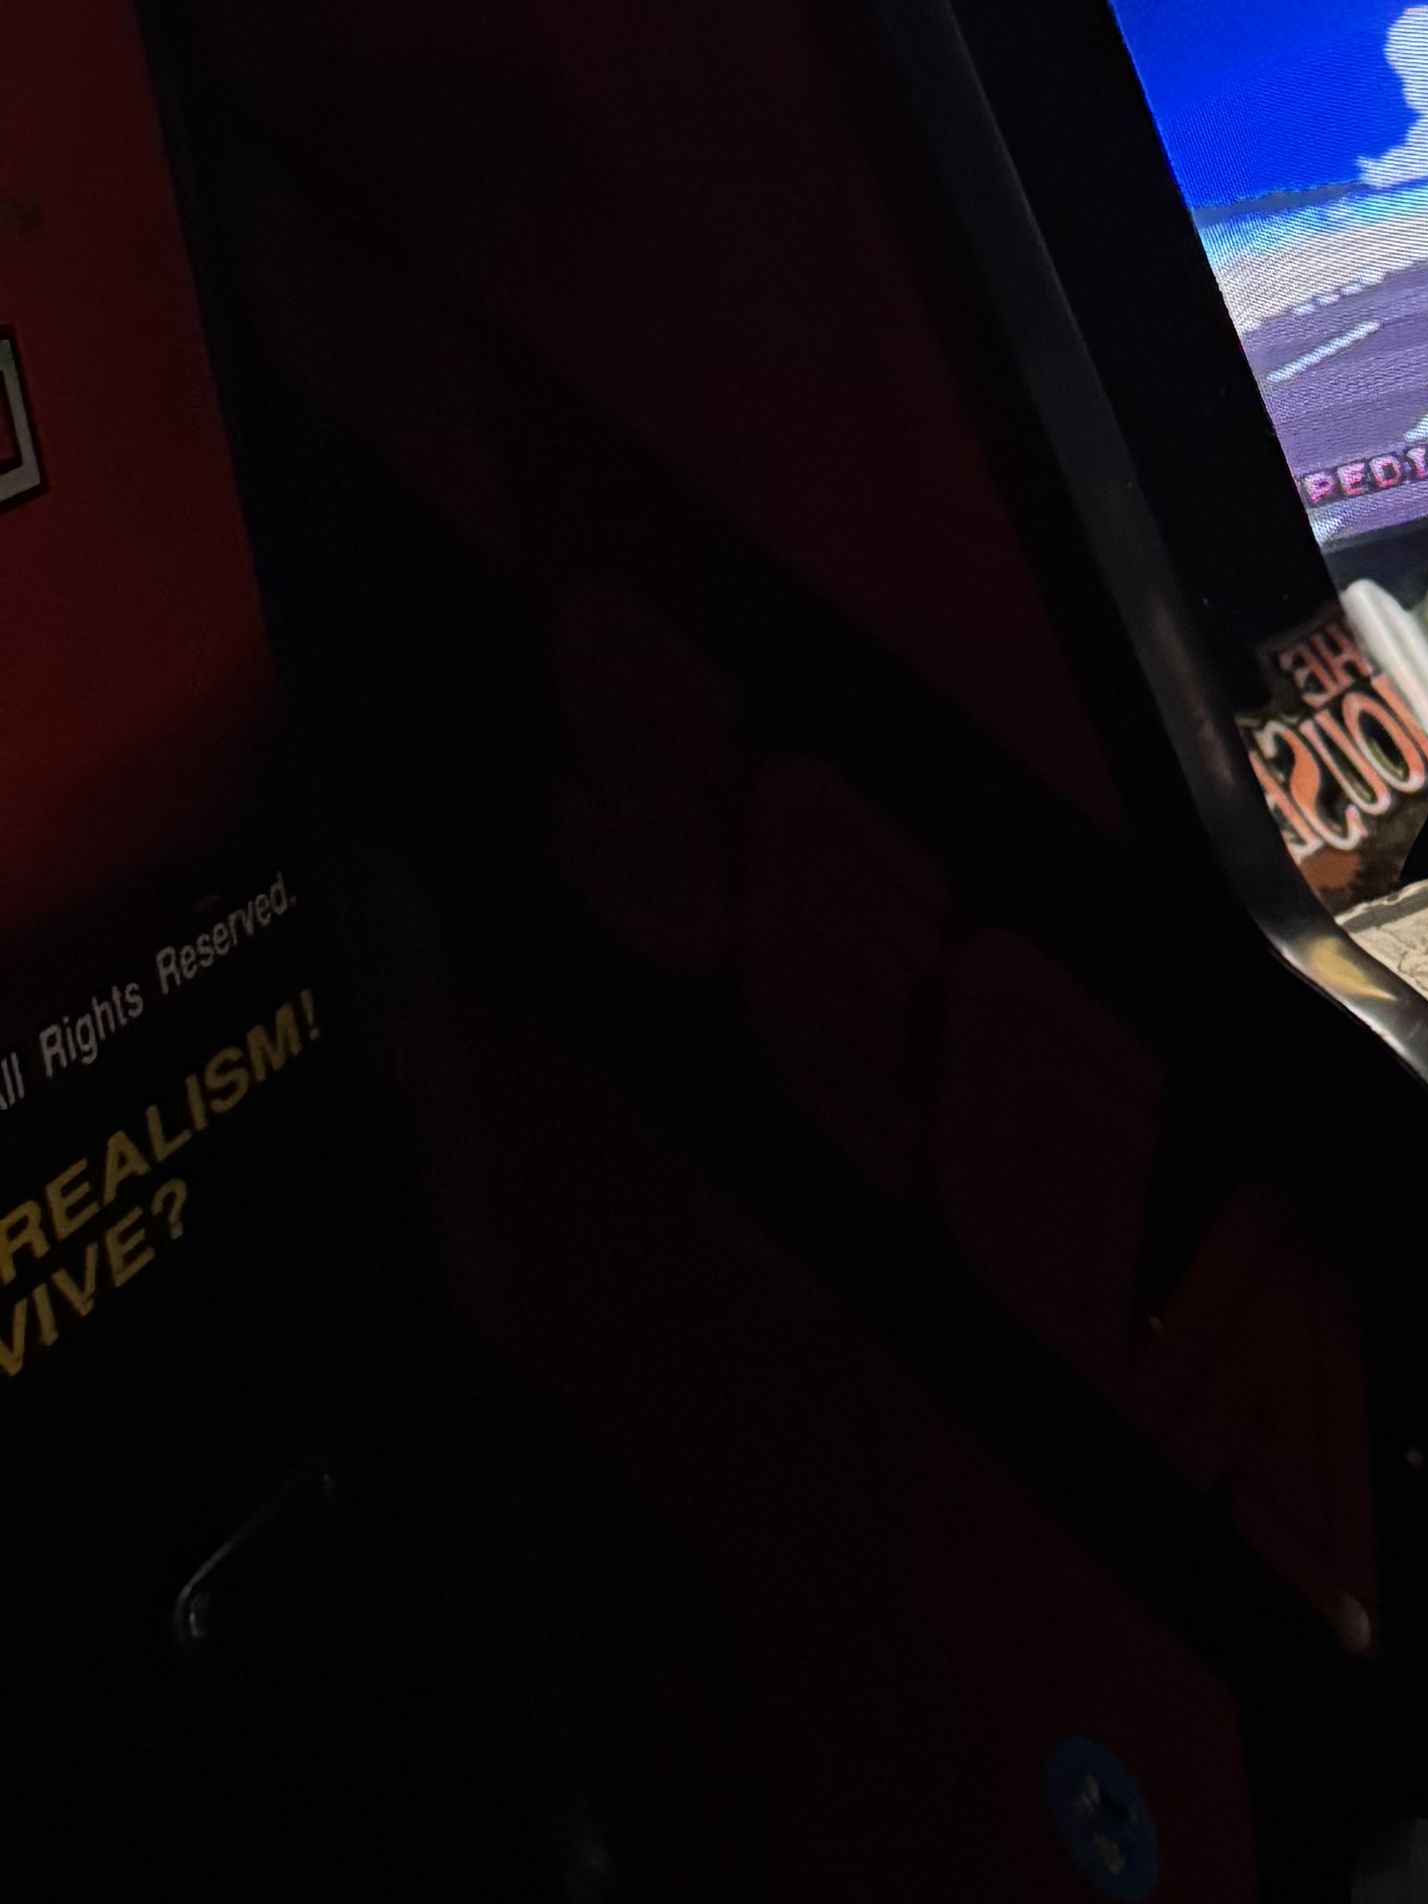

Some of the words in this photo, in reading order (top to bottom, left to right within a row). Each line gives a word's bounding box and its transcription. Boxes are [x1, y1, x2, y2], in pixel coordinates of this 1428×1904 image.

[39, 981, 145, 1079] Rights
[155, 869, 297, 996] Reserved.
[0, 988, 321, 1286] REALISM!
